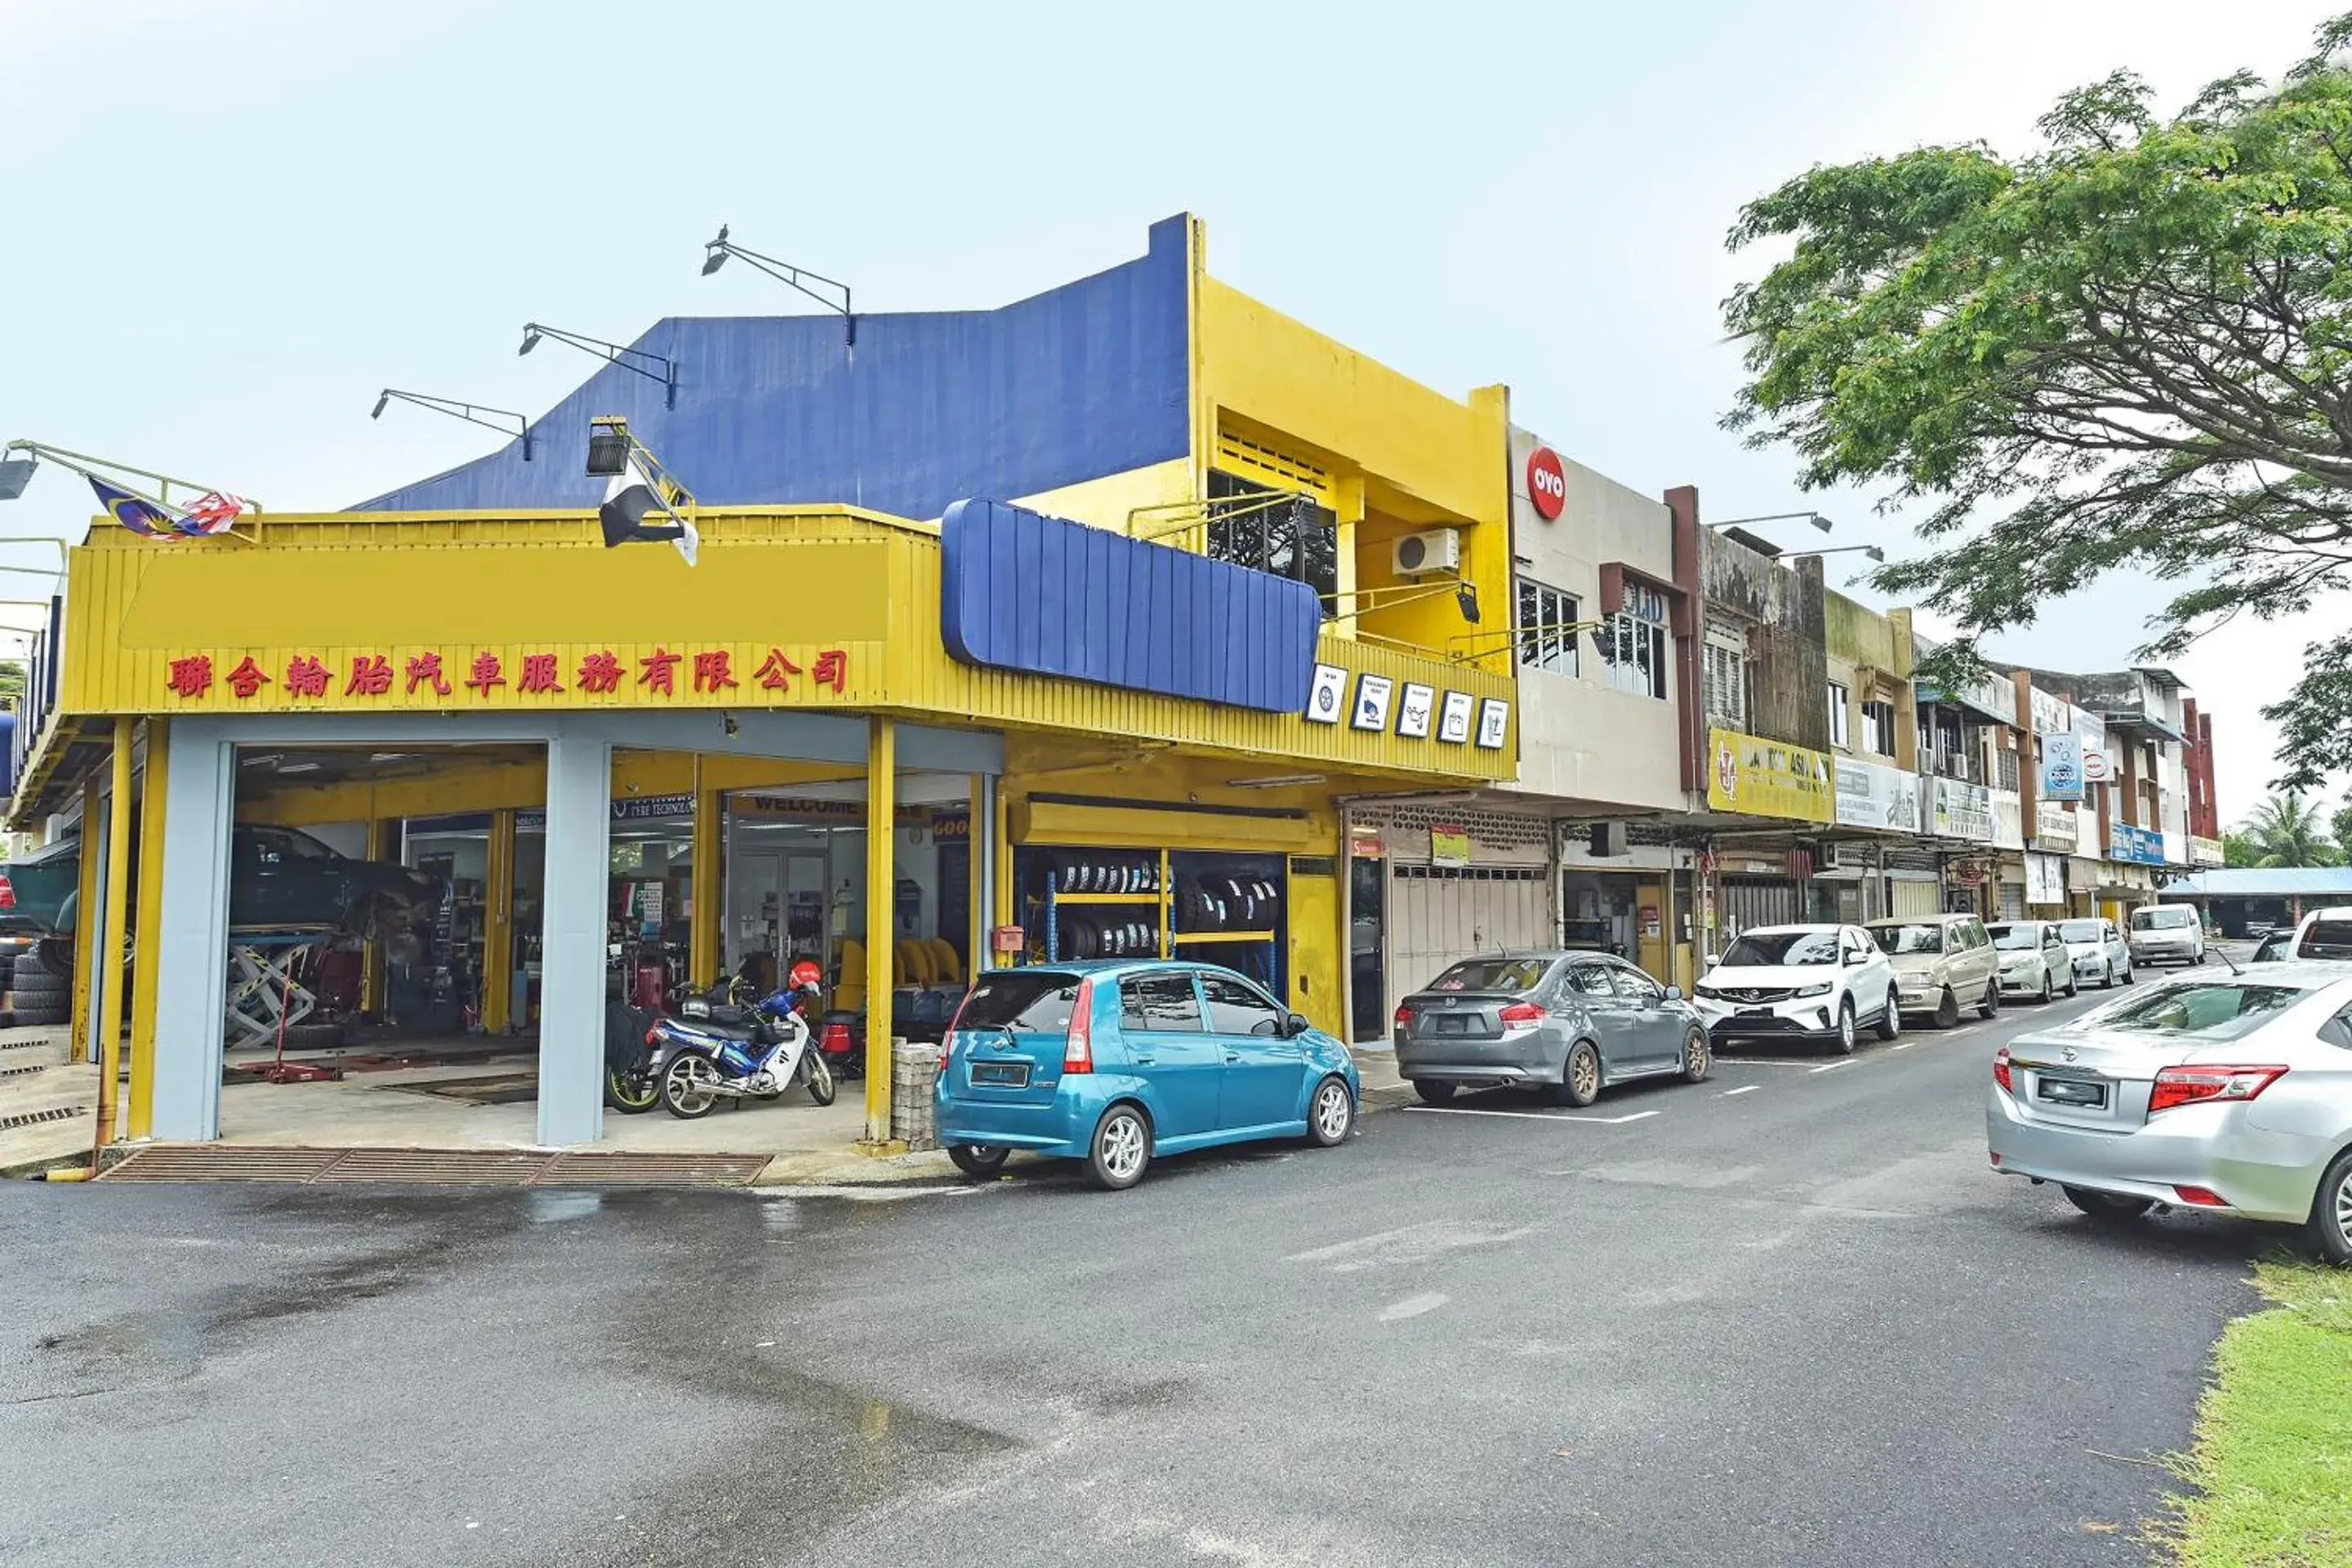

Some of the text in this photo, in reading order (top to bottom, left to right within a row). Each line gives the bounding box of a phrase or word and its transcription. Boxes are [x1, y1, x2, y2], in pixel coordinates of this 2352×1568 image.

[1534, 467, 1564, 498] OYO
[167, 648, 849, 698] 聯合輪胎汽車服務有限公司
[653, 802, 693, 815] TECHNOLO
[754, 795, 858, 814] WELCOME
[935, 819, 971, 835] GOO
